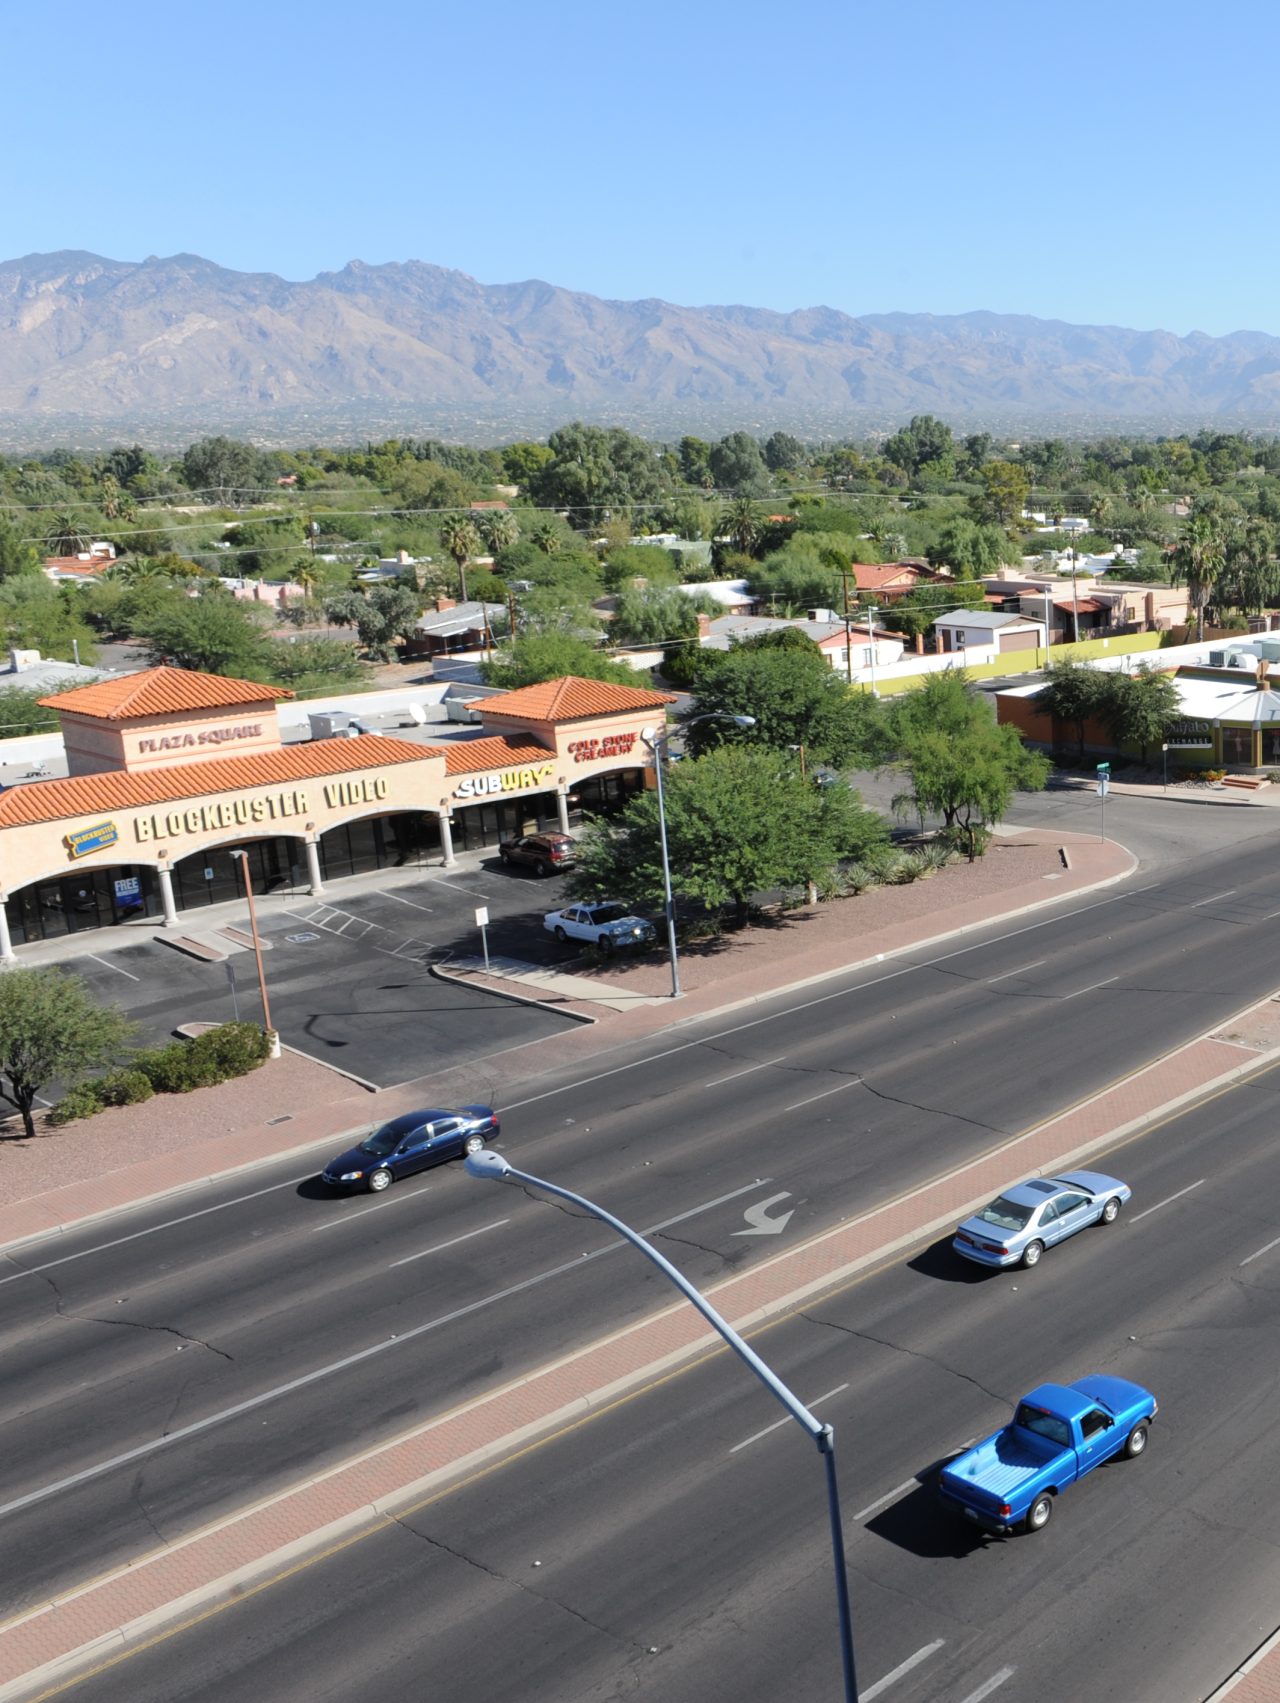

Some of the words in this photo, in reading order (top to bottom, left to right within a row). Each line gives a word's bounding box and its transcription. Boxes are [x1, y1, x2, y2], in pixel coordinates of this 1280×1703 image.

[139, 732, 195, 753] PLAZA
[197, 724, 263, 746] SQUARE
[568, 739, 599, 754] COLD
[602, 732, 638, 748] STONE
[574, 744, 633, 763] CREAMERY
[453, 764, 555, 798] SUBWAY
[135, 790, 308, 843] BLOCKBUSTER
[323, 776, 391, 809] VIDEO
[74, 824, 116, 844] BLOCKBUSTER
[114, 877, 139, 892] FREE
